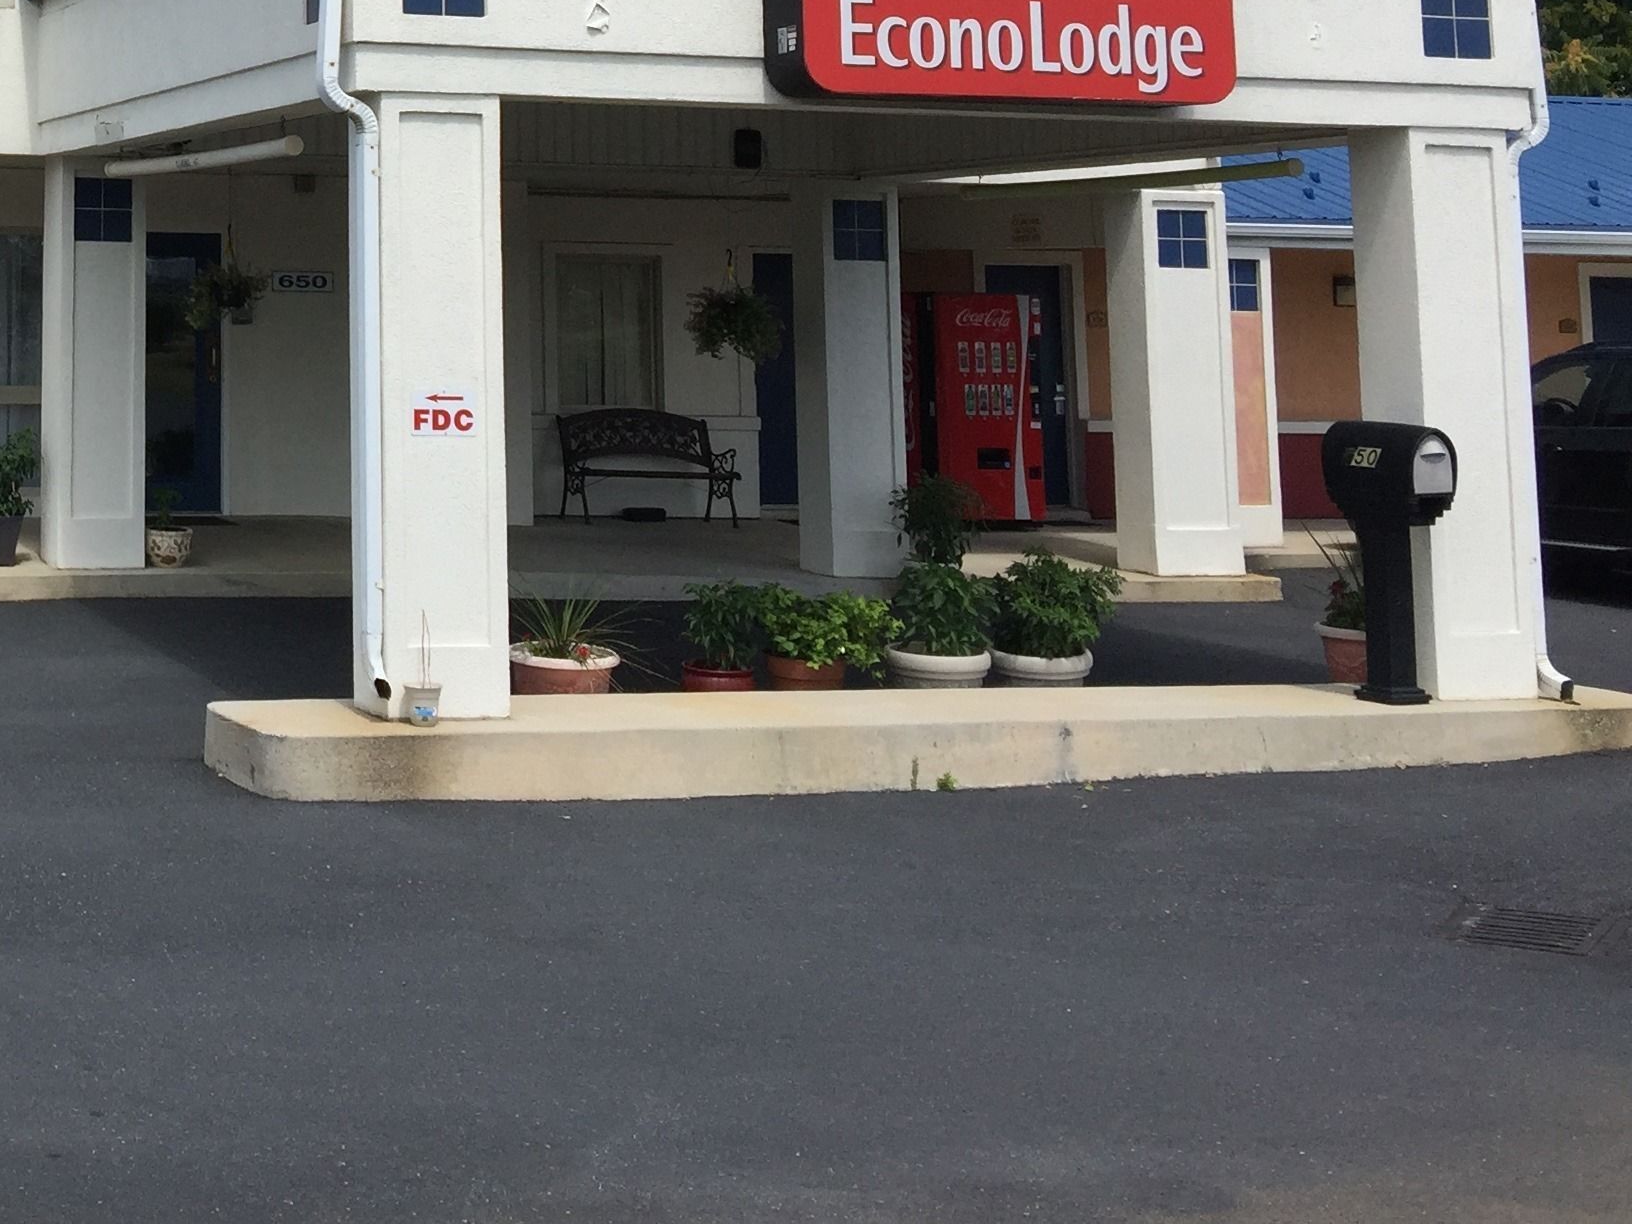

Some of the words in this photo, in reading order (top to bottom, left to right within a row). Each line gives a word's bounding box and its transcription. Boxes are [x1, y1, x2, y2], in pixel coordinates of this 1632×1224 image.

[279, 275, 327, 288] 650
[955, 308, 1012, 328] Coca-Cola
[414, 409, 474, 431] FDC
